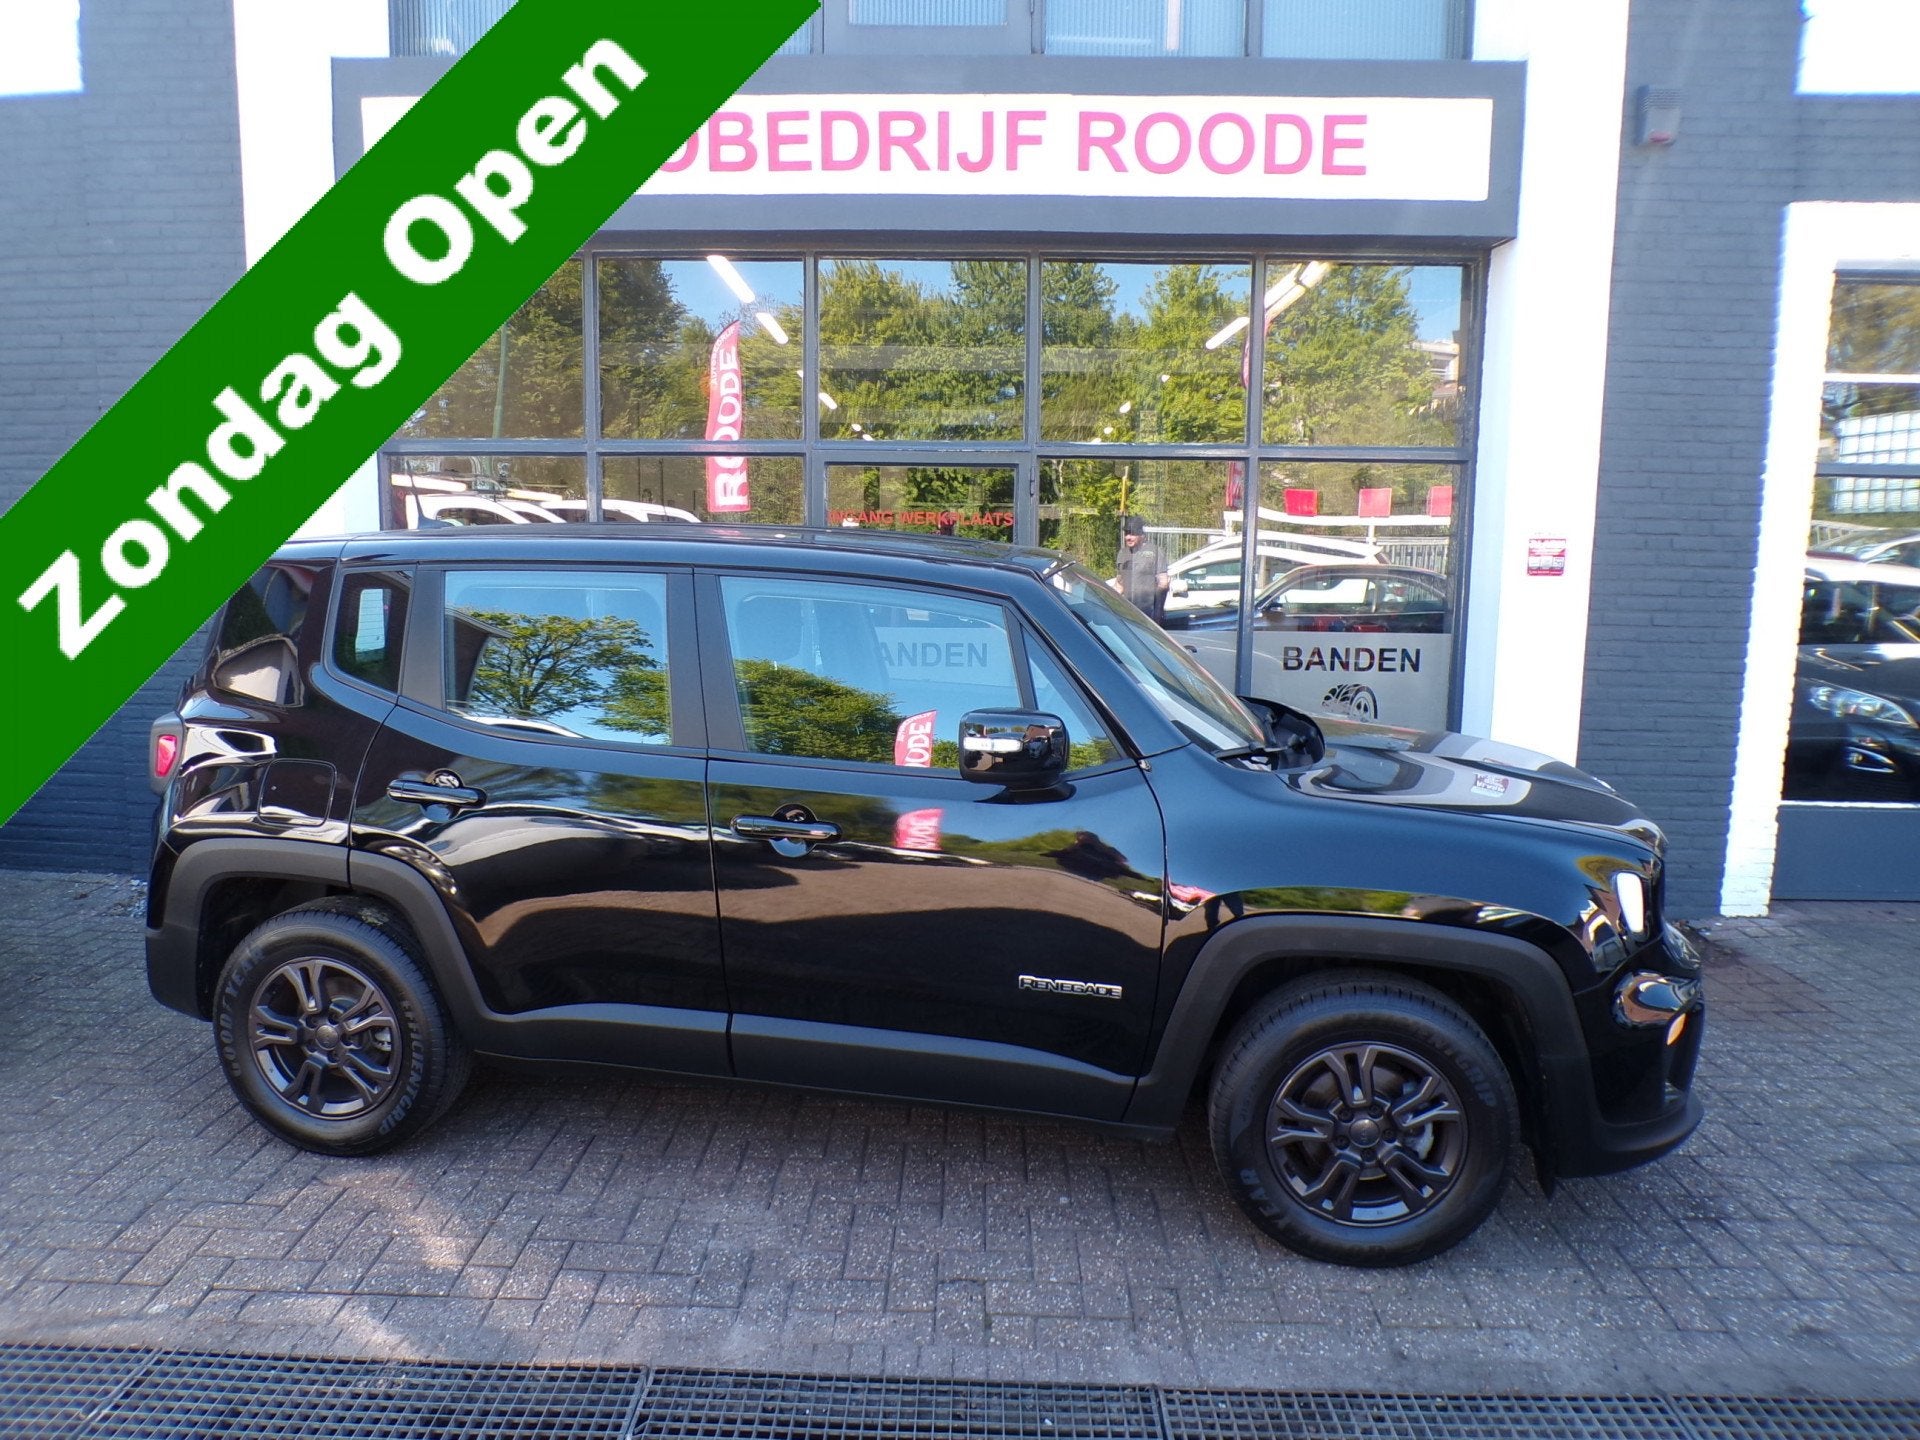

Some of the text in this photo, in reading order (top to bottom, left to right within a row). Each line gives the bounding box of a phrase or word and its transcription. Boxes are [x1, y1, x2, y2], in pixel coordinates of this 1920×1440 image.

[1077, 111, 1368, 176] ROODE
[712, 345, 748, 507] ROODE
[901, 511, 1014, 527] WERKPLAATS
[1282, 645, 1421, 673] BANDEN
[1018, 974, 1122, 999] RENEGADE
